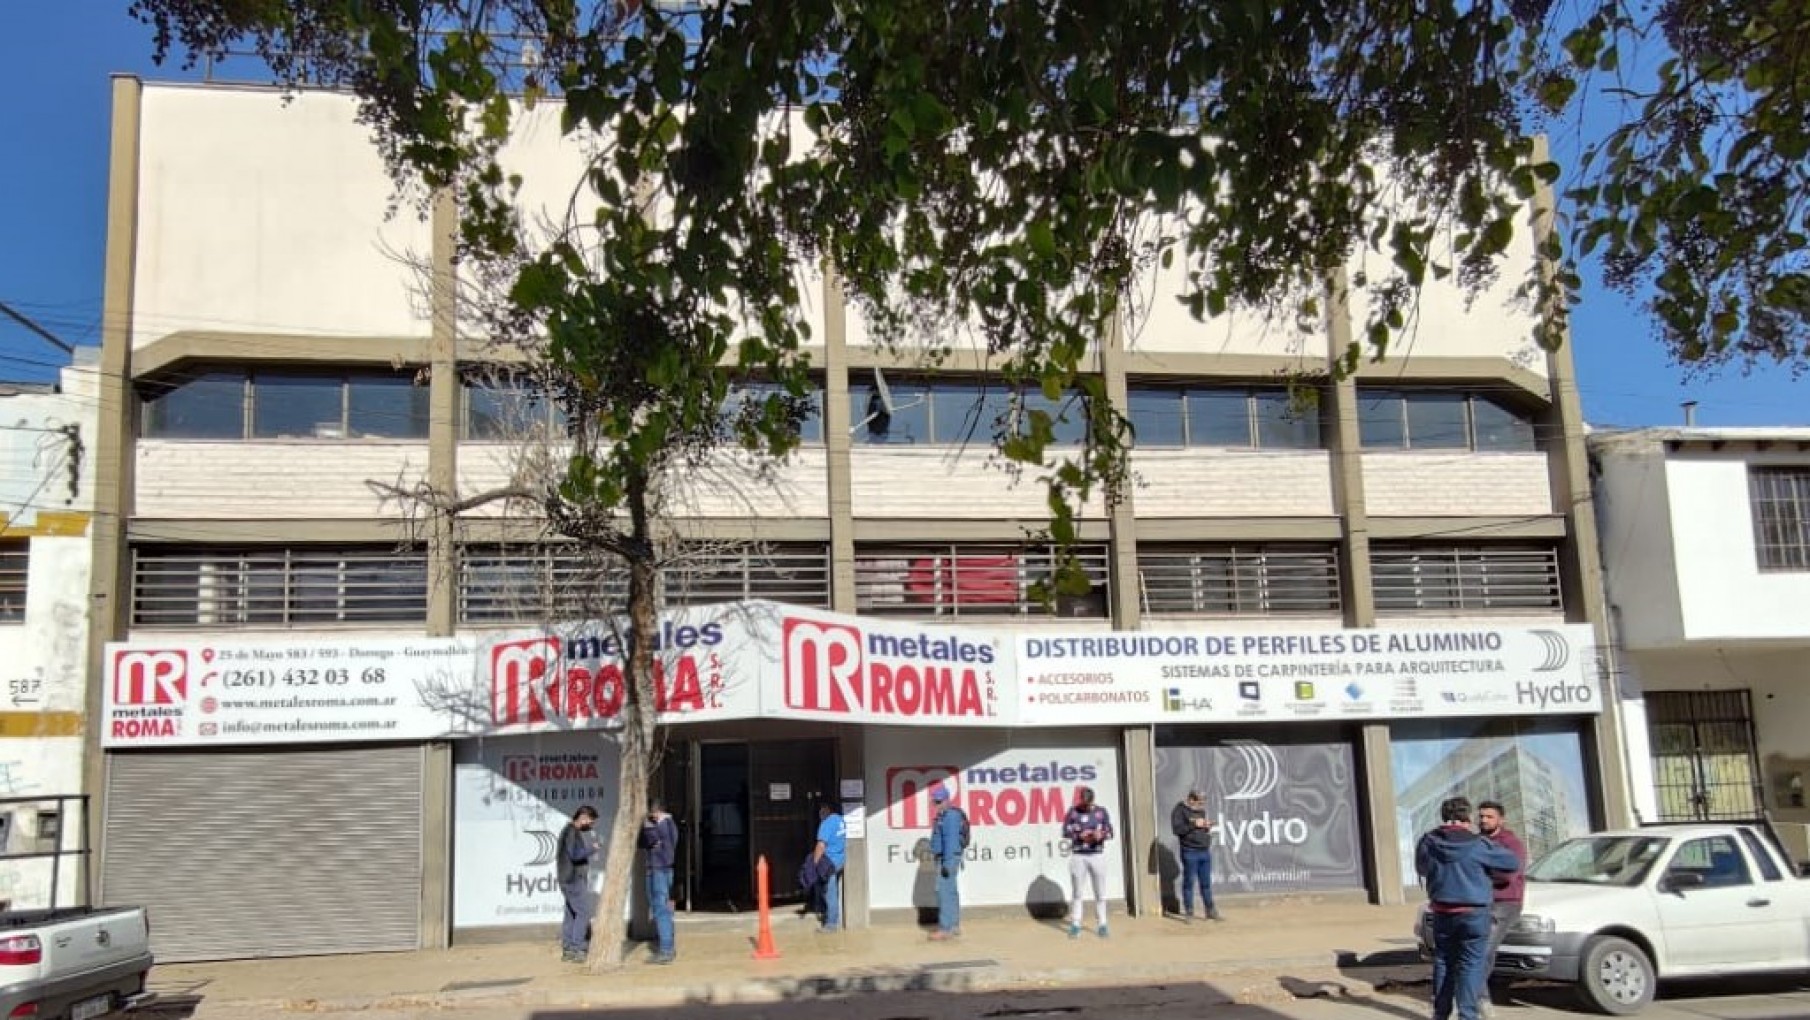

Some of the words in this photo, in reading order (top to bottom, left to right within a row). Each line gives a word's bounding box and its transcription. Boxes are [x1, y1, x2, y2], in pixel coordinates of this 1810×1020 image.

[567, 621, 724, 660] meles
[868, 633, 994, 663] metales
[1026, 635, 1199, 659] DISTRIBUIDOR
[1206, 635, 1237, 657] DE
[1242, 633, 1346, 656] PERFILES
[1352, 633, 1382, 654] DE
[1388, 632, 1502, 653] ALUMINIO
[222, 668, 275, 689] (261)
[281, 668, 320, 686] 432
[325, 668, 350, 685] 03
[360, 667, 386, 684] 68
[1038, 672, 1114, 686] ACCESORIOS
[1160, 665, 1231, 678] SISTEMAS
[1234, 665, 1253, 677] DE
[1356, 662, 1395, 674] PARA
[1400, 660, 1505, 675] ARQUITECTURA
[870, 663, 984, 716] ROMA
[1038, 690, 1151, 704] POLICARBONATOS
[1515, 680, 1592, 709] Hydro
[111, 706, 183, 718] metales
[221, 695, 397, 708] www.metalesroma.com.ar
[111, 719, 175, 738] ROMA
[222, 718, 397, 734] info@metalesroma.com.ar
[540, 763, 599, 781] ROMA
[966, 761, 1097, 784] metales
[888, 842, 993, 864] Fuda
[1004, 845, 1032, 860] en
[506, 872, 563, 896] Hydr
